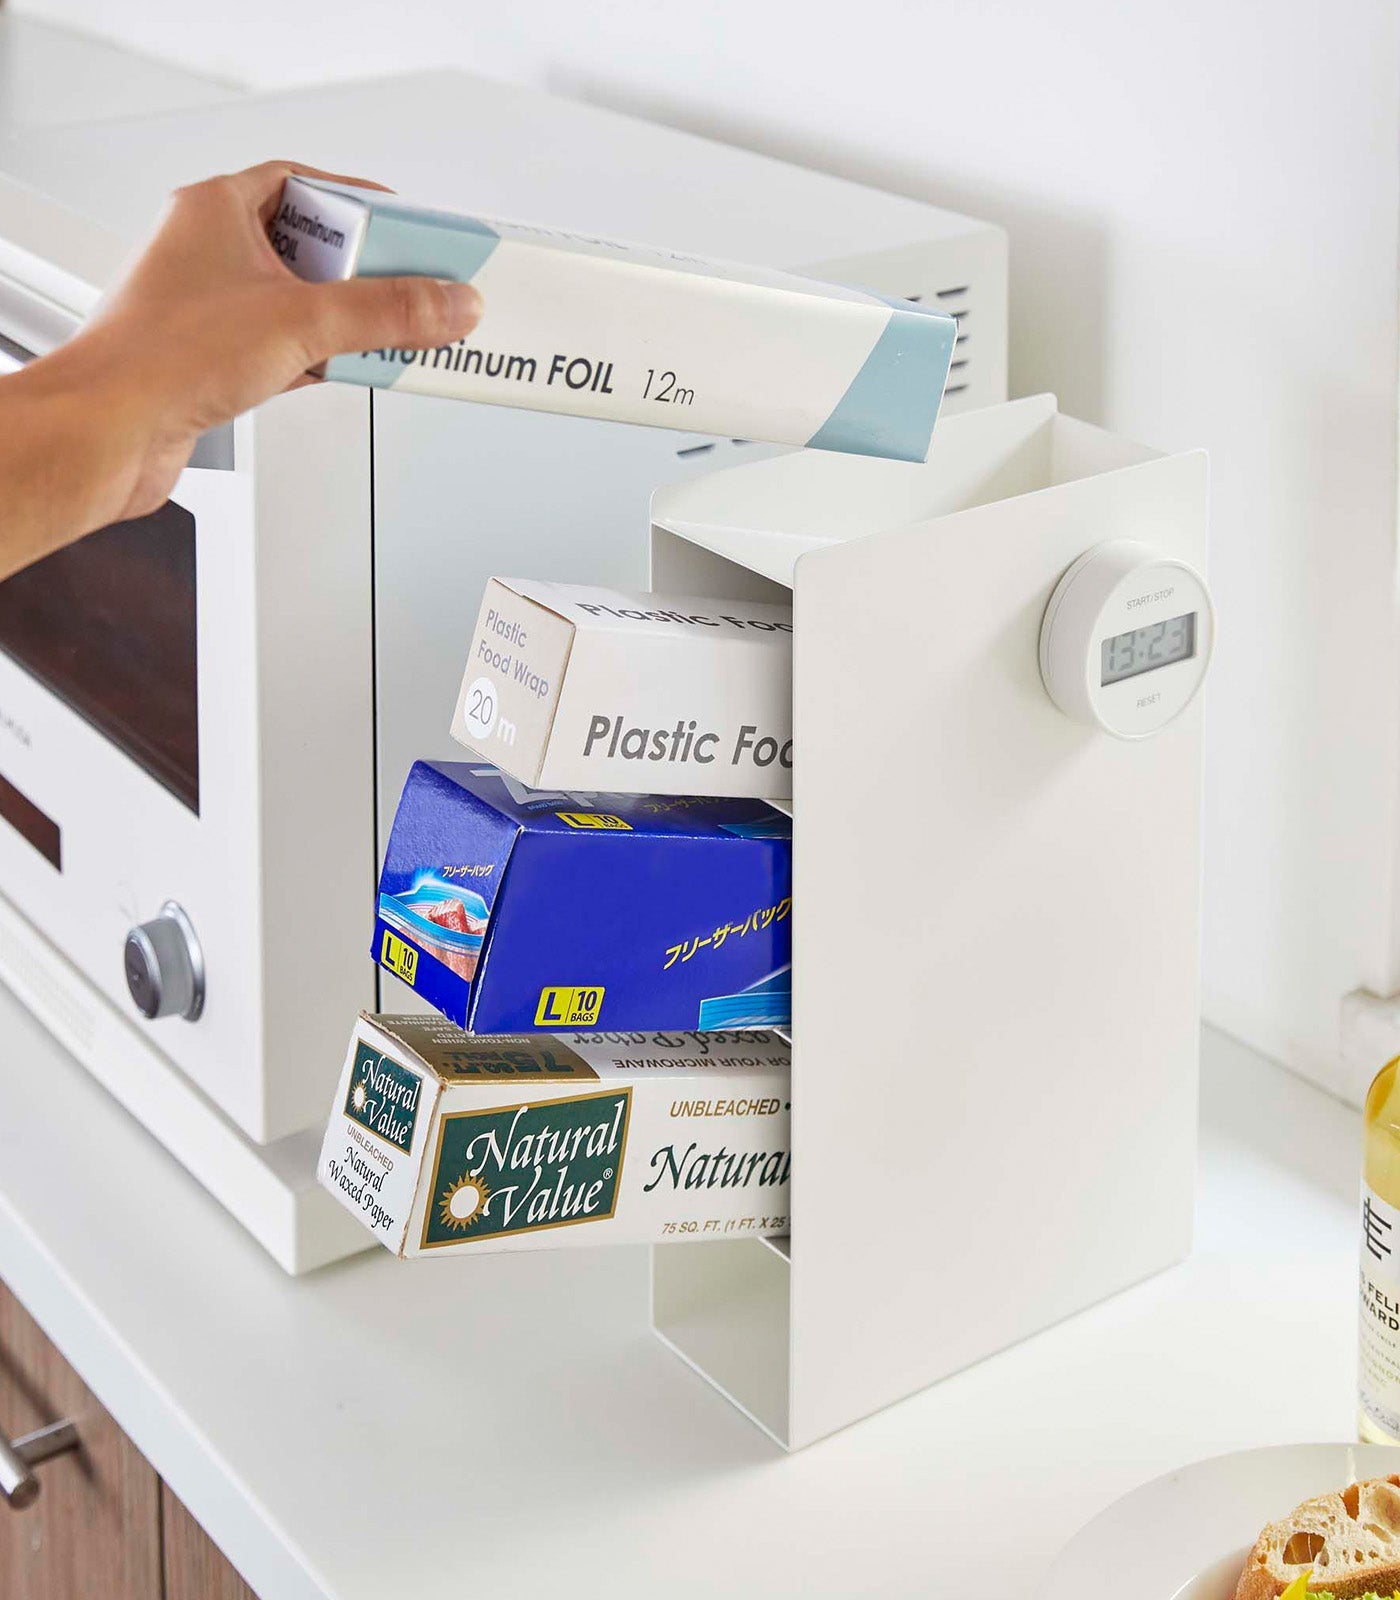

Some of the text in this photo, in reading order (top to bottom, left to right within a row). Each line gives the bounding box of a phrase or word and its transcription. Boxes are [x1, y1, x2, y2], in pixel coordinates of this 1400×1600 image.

[547, 354, 615, 394] FOIL
[642, 368, 696, 406] 12m
[1126, 587, 1174, 610] START/STOP
[575, 602, 720, 625] Plastic
[485, 609, 527, 648] Plastic
[476, 639, 549, 699] Food Wrap
[468, 689, 493, 725] 20
[1136, 692, 1161, 708] RESET
[497, 716, 517, 747] m
[583, 714, 720, 764] Plastic
[564, 814, 596, 826] L
[592, 815, 619, 826] 10
[385, 936, 396, 966] L
[403, 947, 414, 970] 10
[399, 965, 413, 982] BAGS
[543, 992, 561, 1021] L
[577, 990, 598, 1012] 10
[570, 1012, 595, 1022] BAGS
[503, 1050, 574, 1073] 75
[612, 1058, 715, 1069] MICROWAVE
[719, 1058, 764, 1067] YOUR
[361, 1054, 421, 1112] Natural
[669, 1098, 780, 1118] UNBLEACHED
[347, 1124, 395, 1172] UNBLEACHED
[466, 1099, 625, 1177] Natural
[344, 1146, 389, 1193] Natural
[328, 1159, 394, 1231] Waxed Paper
[661, 1222, 677, 1235] 75
[678, 1221, 700, 1234] SQ.
[703, 1220, 721, 1232] FT.
[738, 1217, 756, 1230] FT.
[758, 1216, 770, 1229] X
